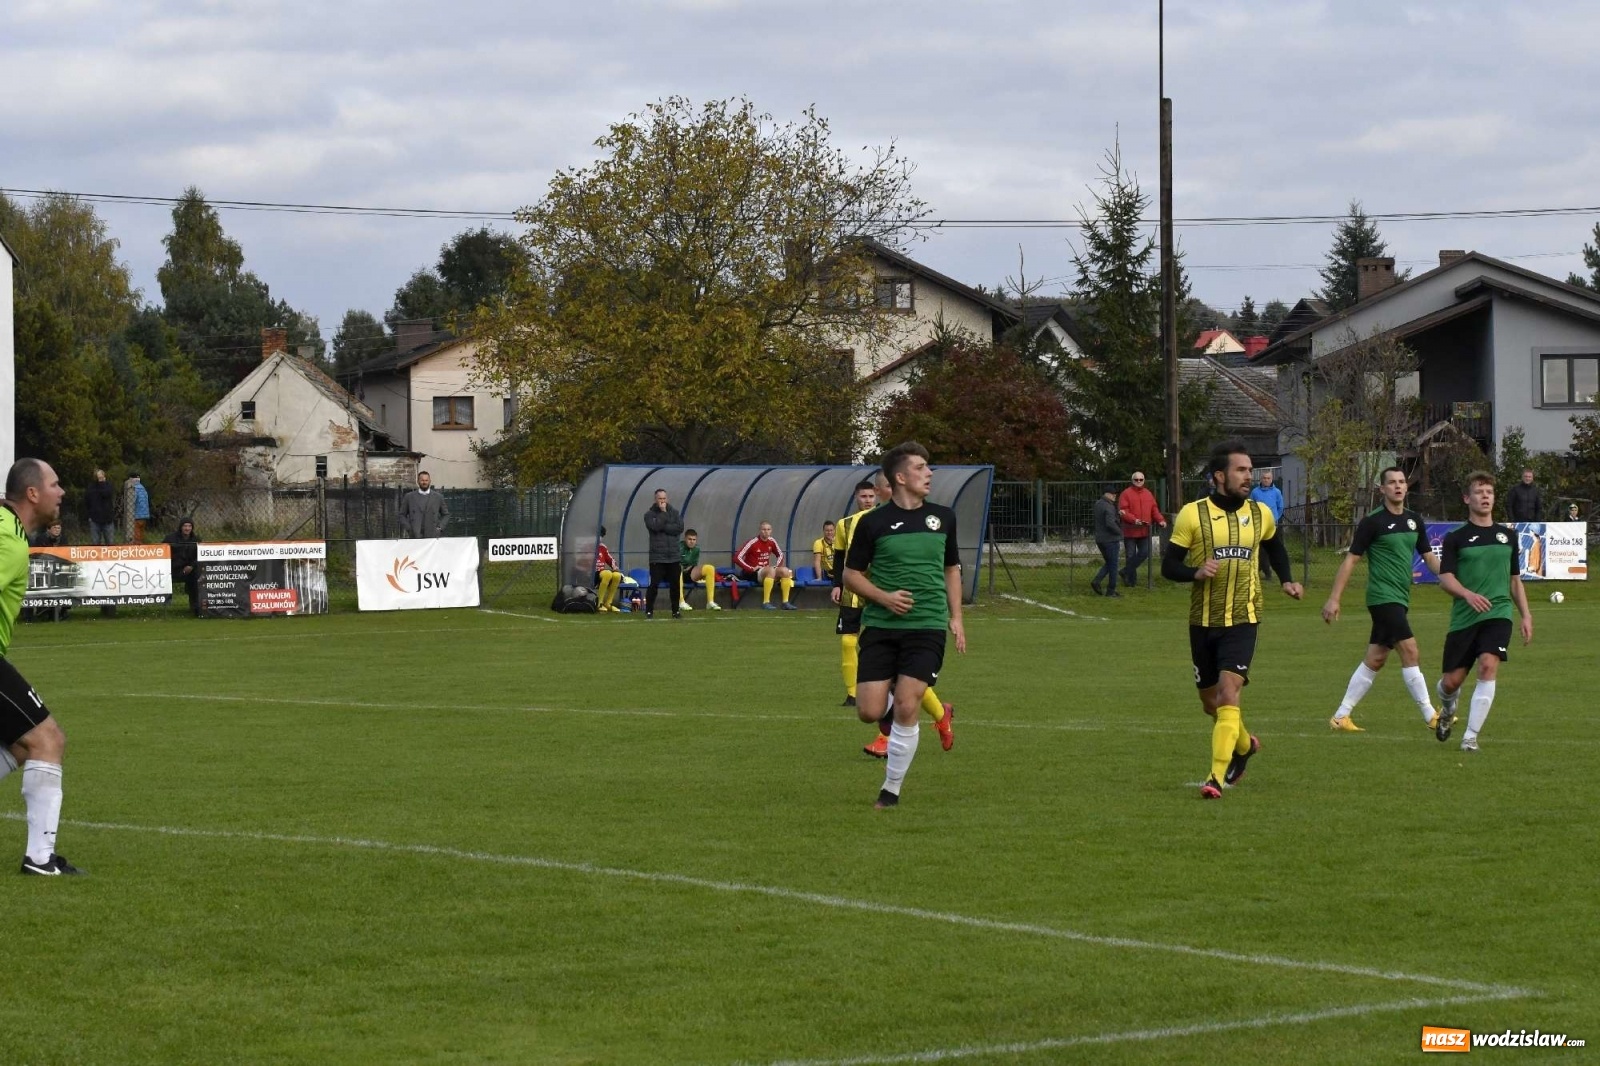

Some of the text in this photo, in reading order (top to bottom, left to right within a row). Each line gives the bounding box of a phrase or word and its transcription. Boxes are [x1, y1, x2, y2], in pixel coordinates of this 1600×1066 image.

[70, 546, 164, 560] Biuro Projektowe
[228, 548, 275, 556] REMONTOWO
[491, 543, 555, 556] GOSPODARZE
[1214, 547, 1251, 560] SEGET
[416, 572, 450, 592] JSW
[128, 597, 154, 606] Asnyka
[256, 592, 291, 600] WYNAJEM
[252, 600, 296, 610] SZALUNKÓW
